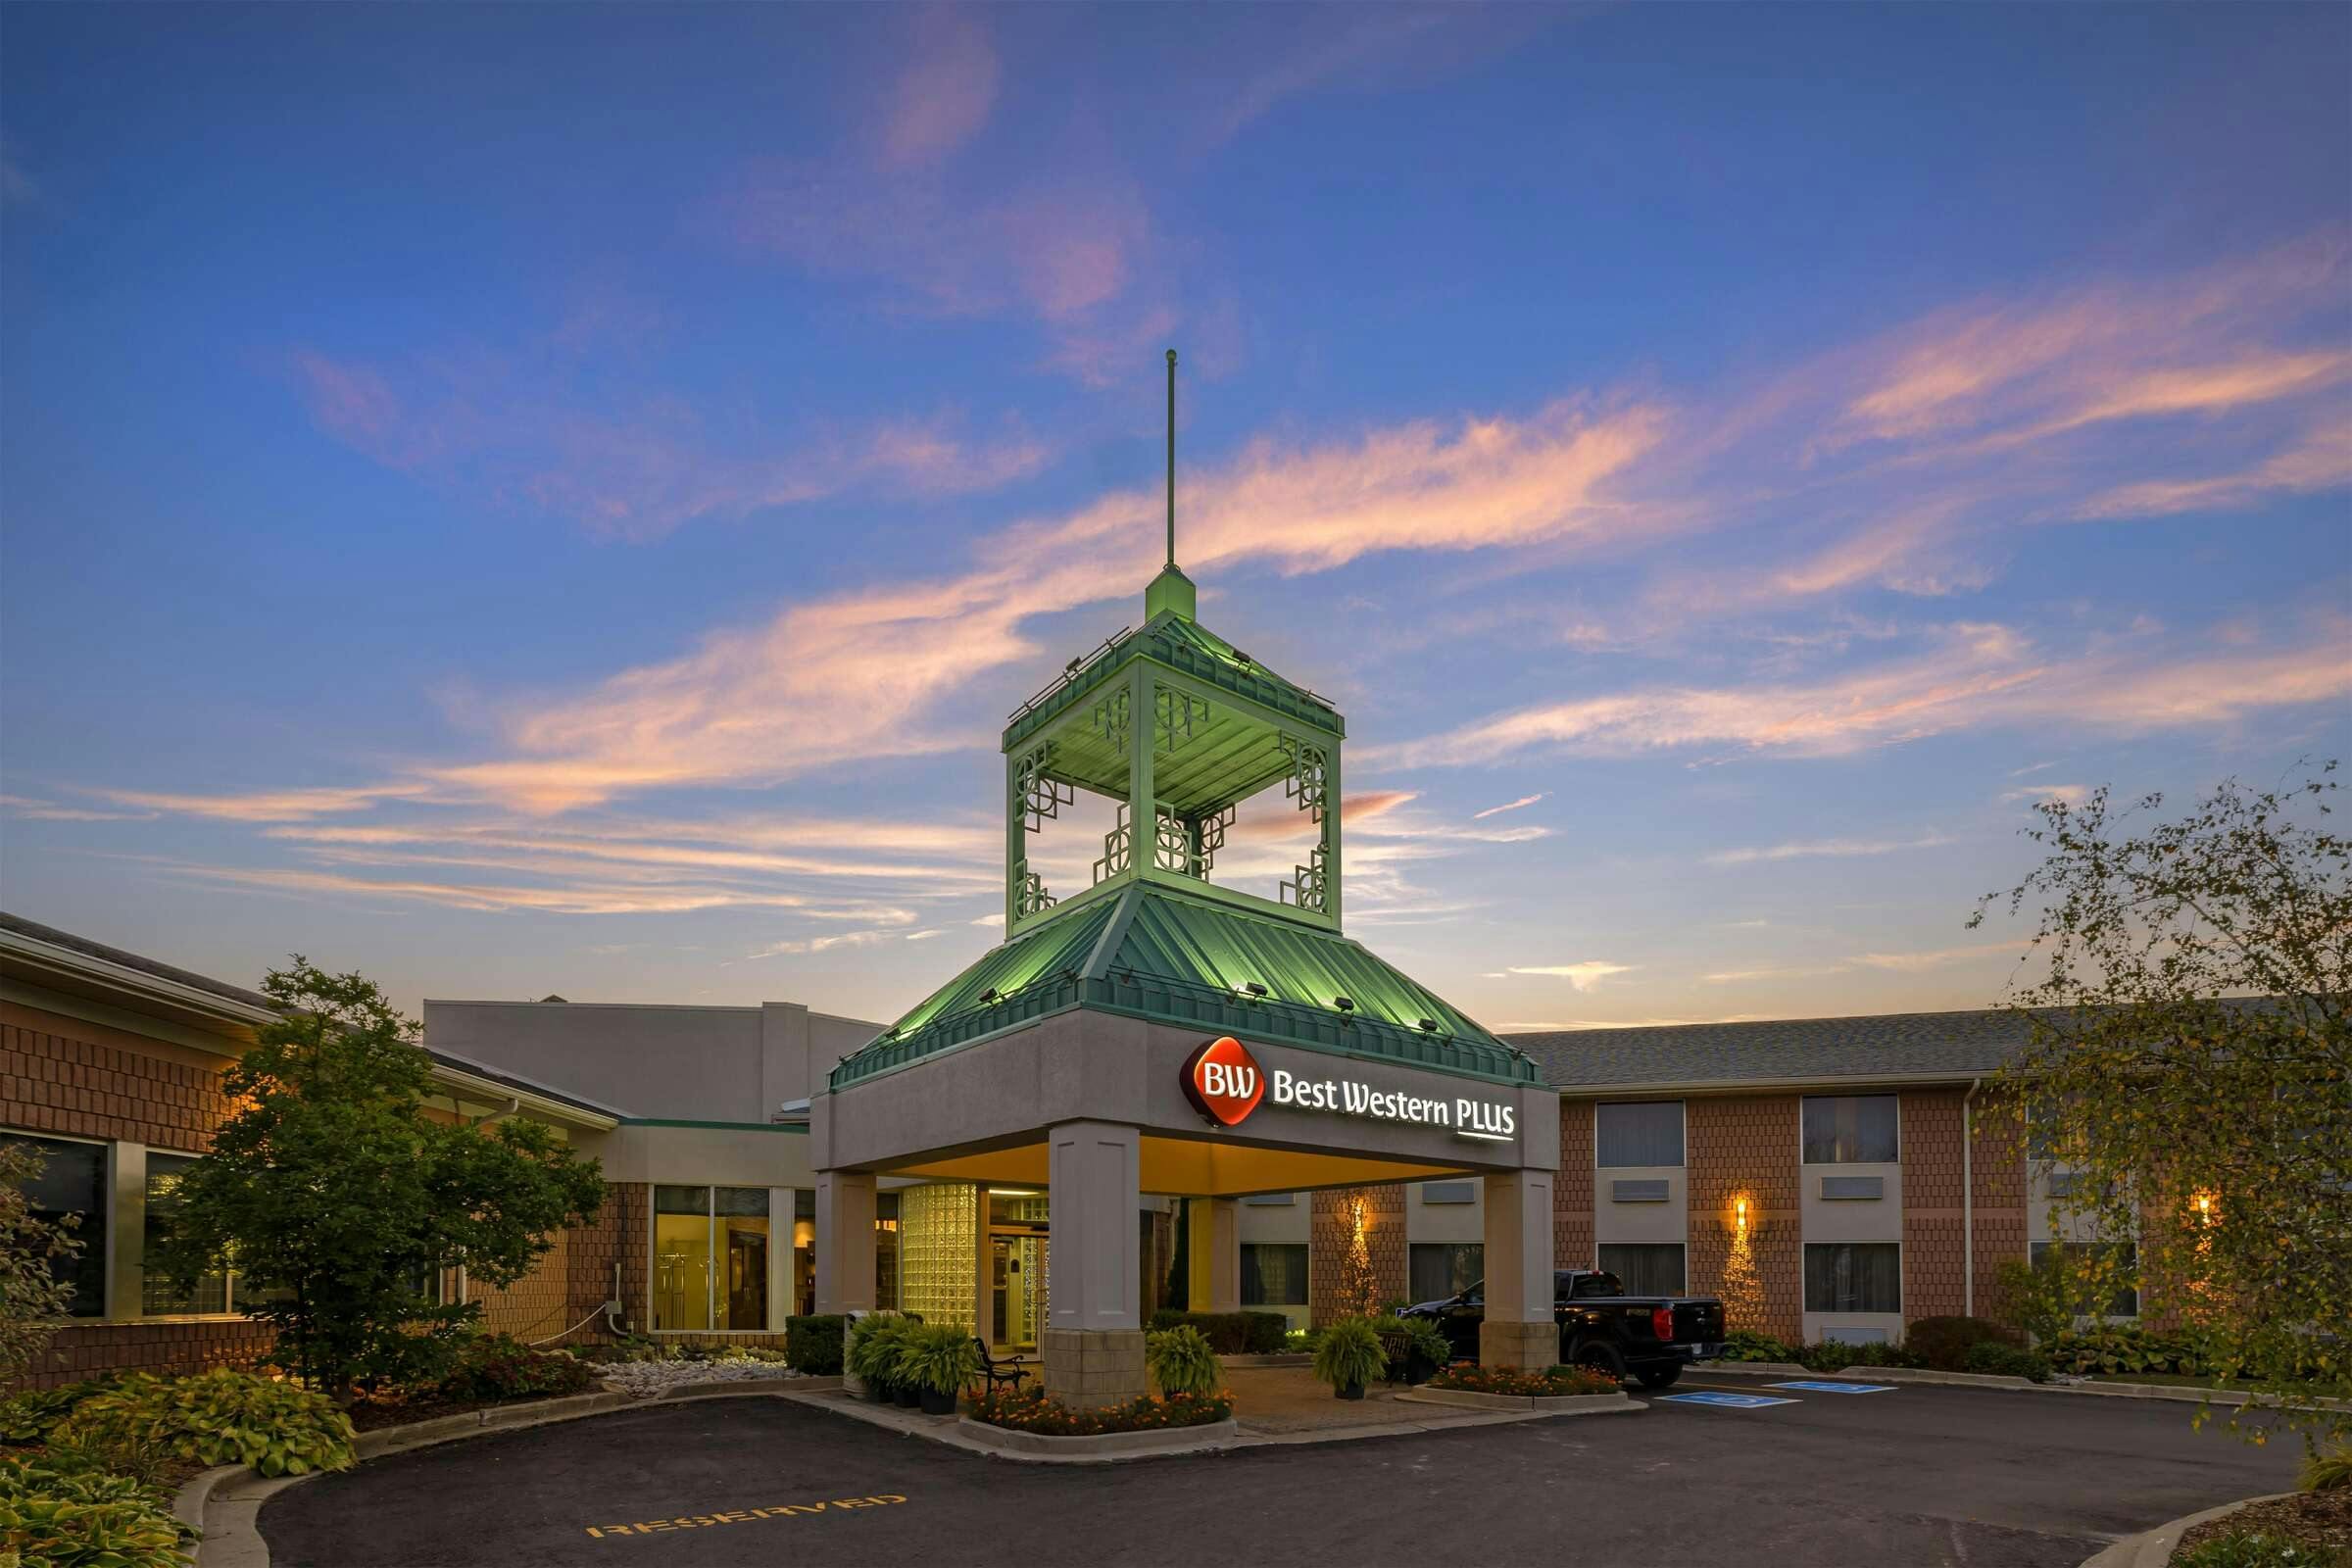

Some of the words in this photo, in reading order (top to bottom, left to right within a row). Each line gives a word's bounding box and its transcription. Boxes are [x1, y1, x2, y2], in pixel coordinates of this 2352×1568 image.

[1204, 1062, 1255, 1100] BW
[1274, 1070, 1338, 1109] Best
[1343, 1081, 1449, 1125] Western
[1457, 1099, 1515, 1135] PLUS
[585, 1494, 907, 1538] RESERVED
